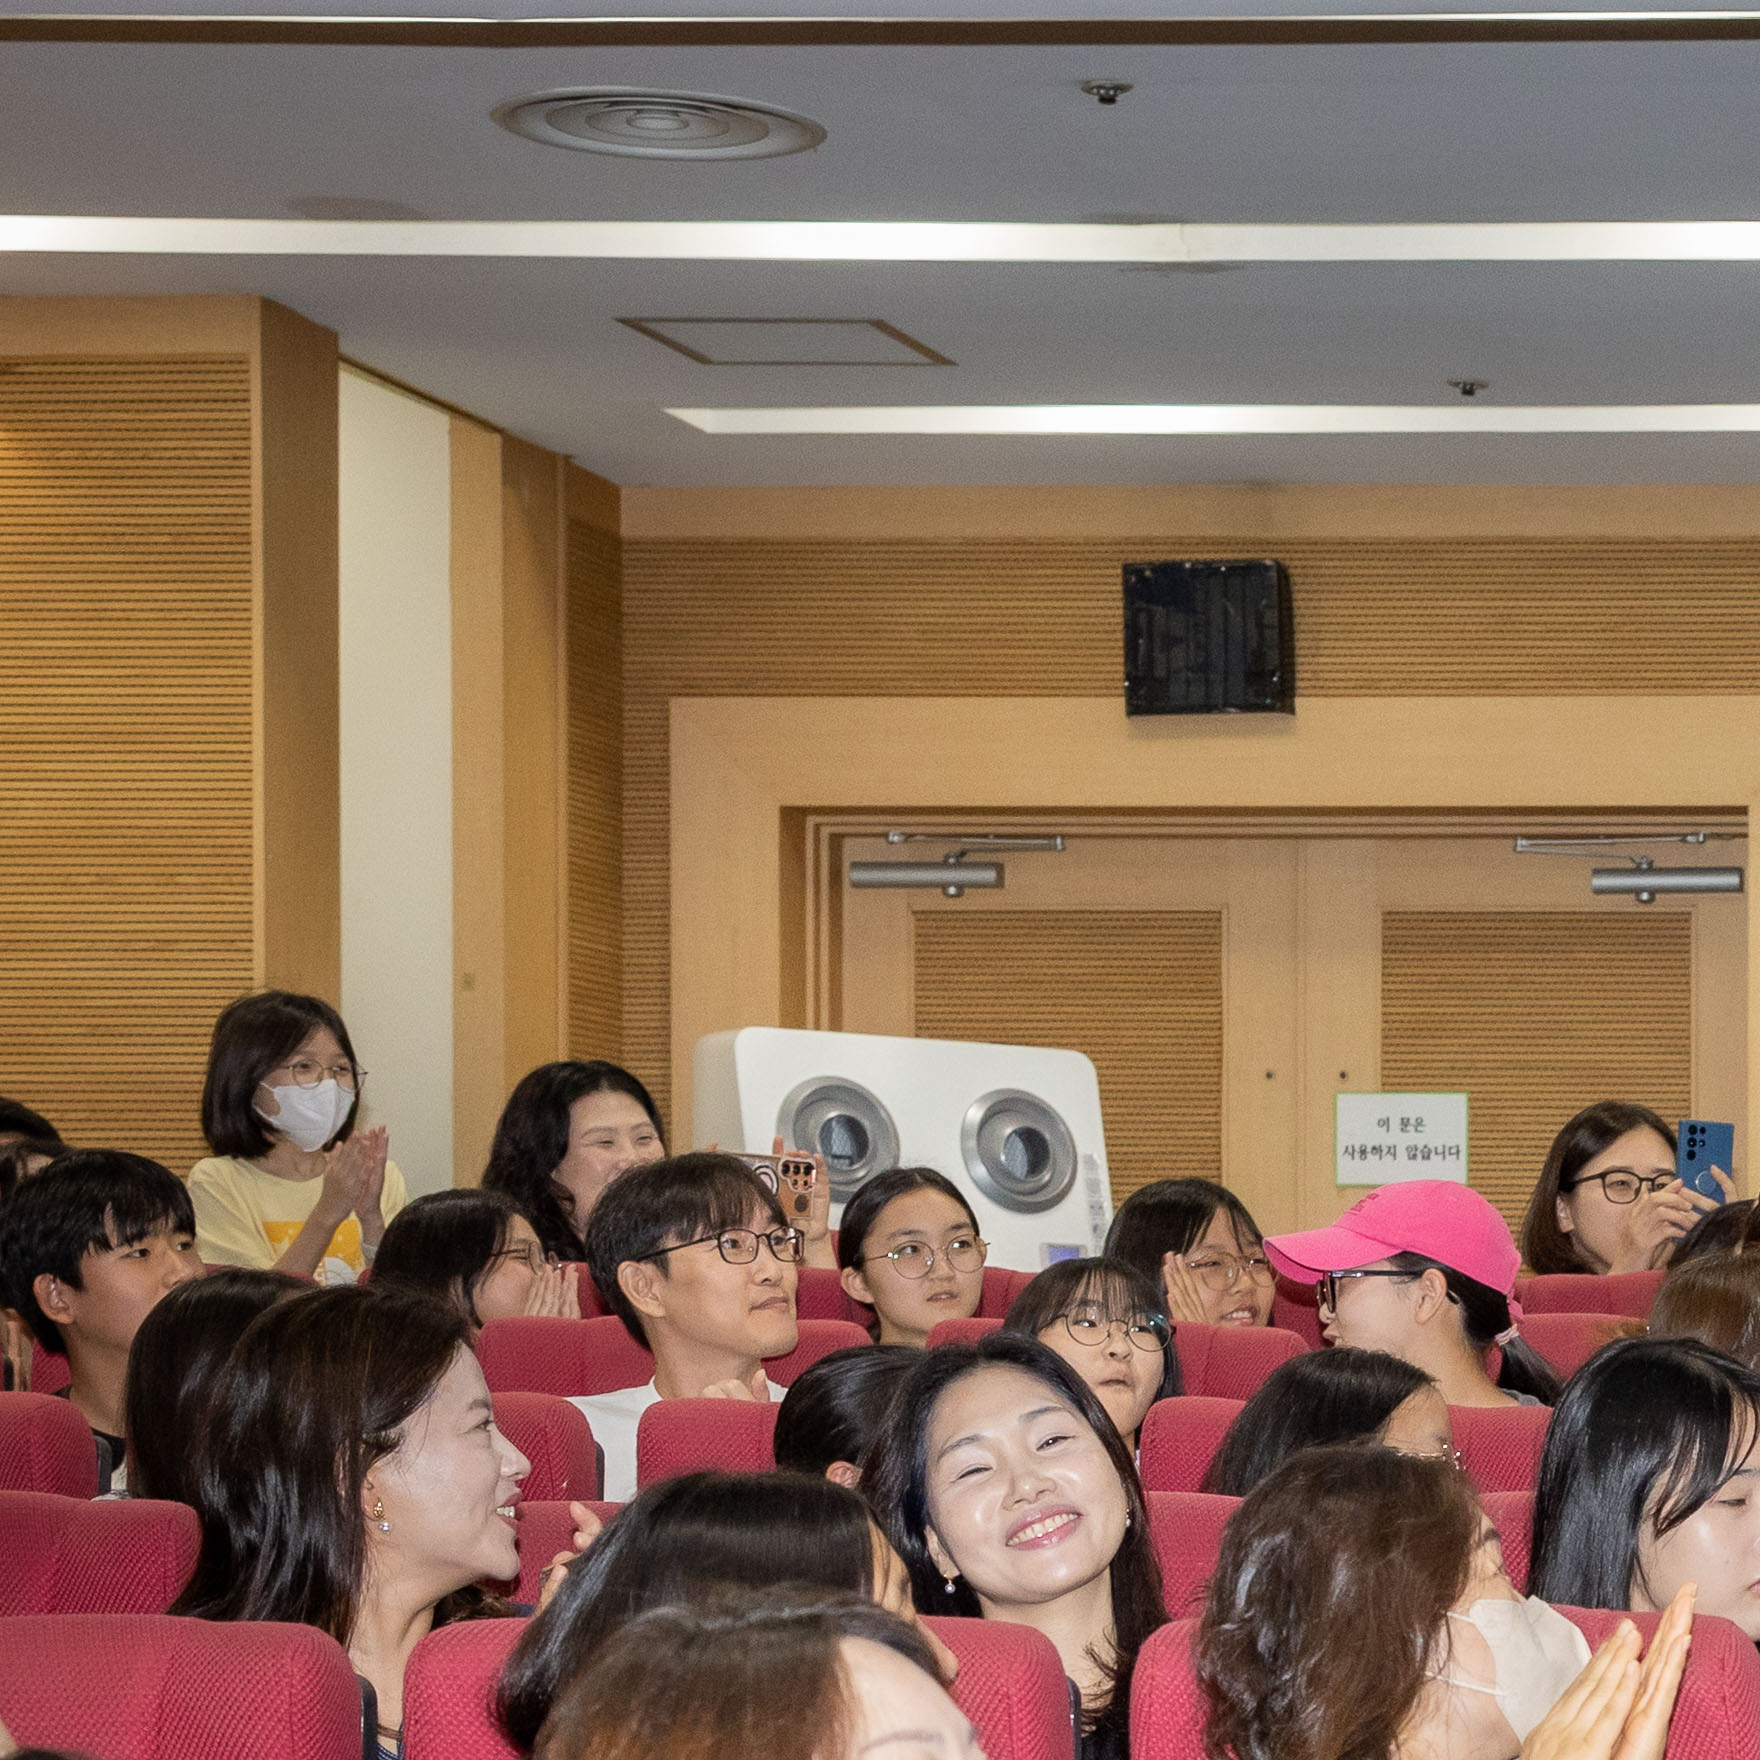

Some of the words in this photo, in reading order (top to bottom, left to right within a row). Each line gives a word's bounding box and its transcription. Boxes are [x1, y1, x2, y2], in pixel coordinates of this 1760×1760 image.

[1377, 1116, 1390, 1134] 이
[1399, 1116, 1427, 1134] 문은
[1342, 1143, 1397, 1161] 사용하지
[1405, 1143, 1461, 1161] 않습니다
